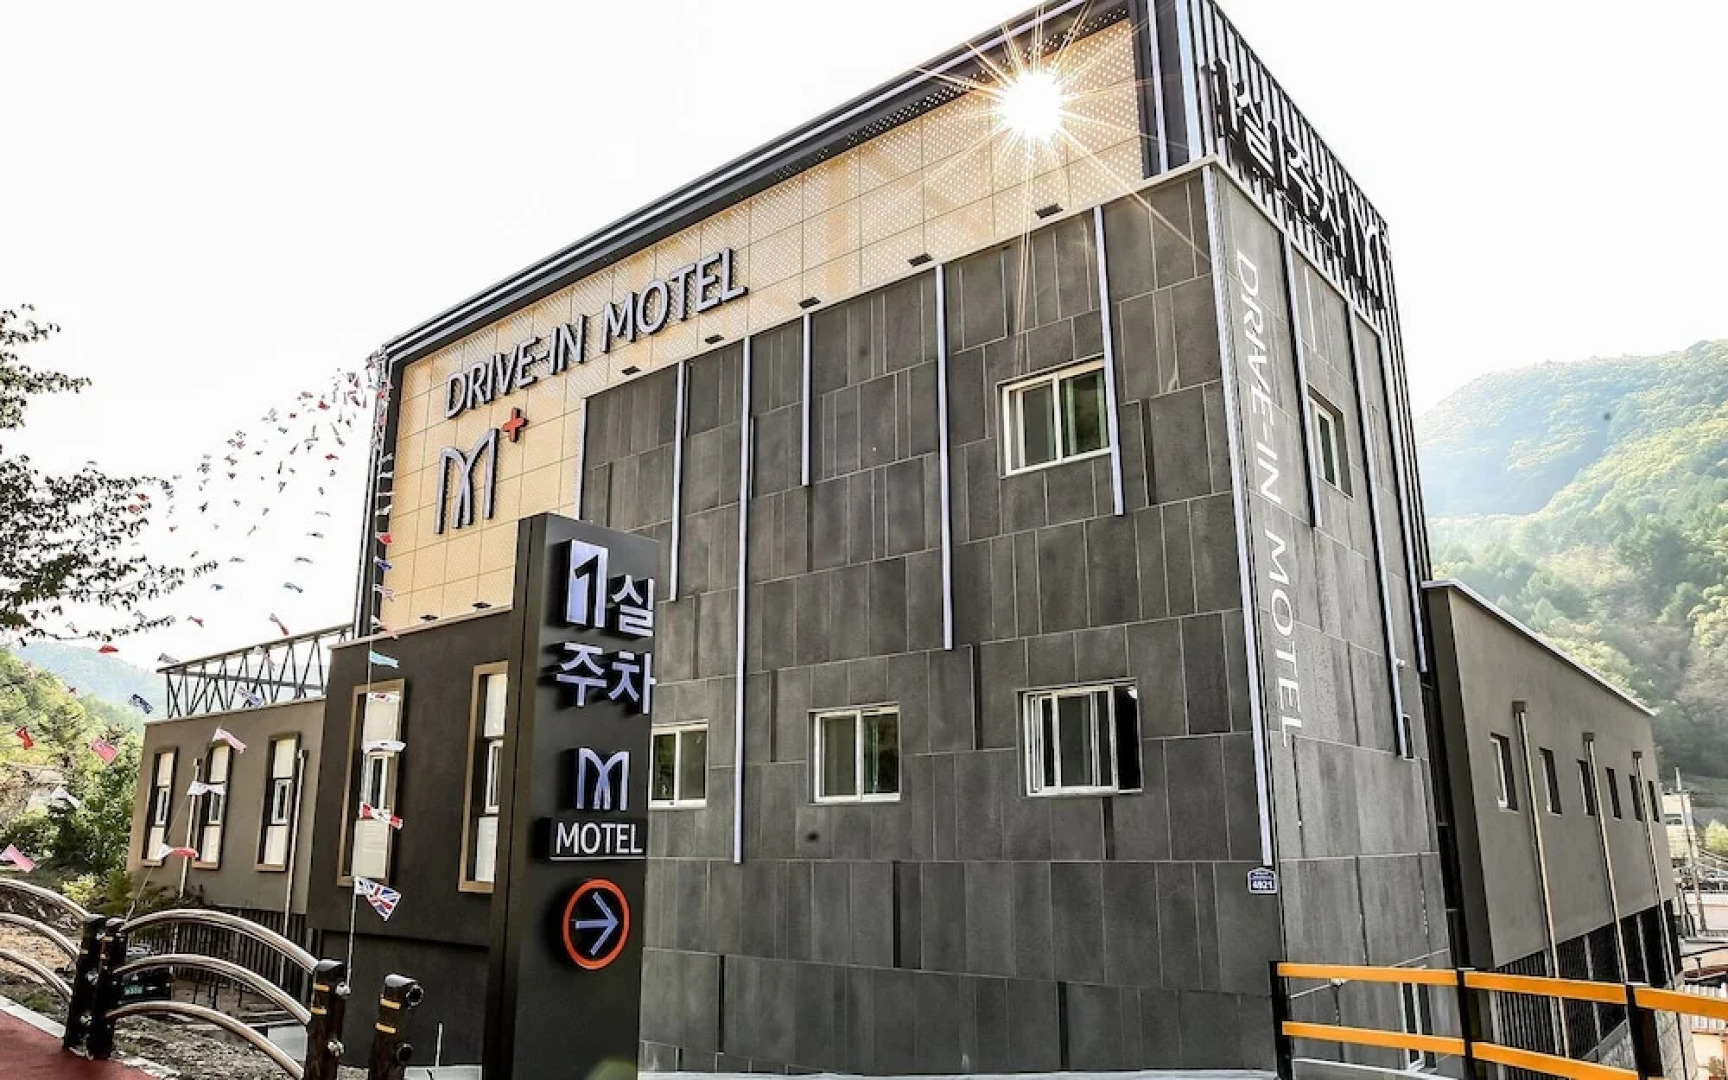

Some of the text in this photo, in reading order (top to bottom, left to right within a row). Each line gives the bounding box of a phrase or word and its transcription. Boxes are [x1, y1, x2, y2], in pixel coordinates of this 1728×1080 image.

[445, 248, 749, 419] DRIVE-IN MOTEL
[1237, 248, 1302, 747] DRIVE-IN MOTEL
[555, 641, 658, 715] 주차
[576, 747, 629, 812] M
[555, 821, 643, 856] MOTEL
